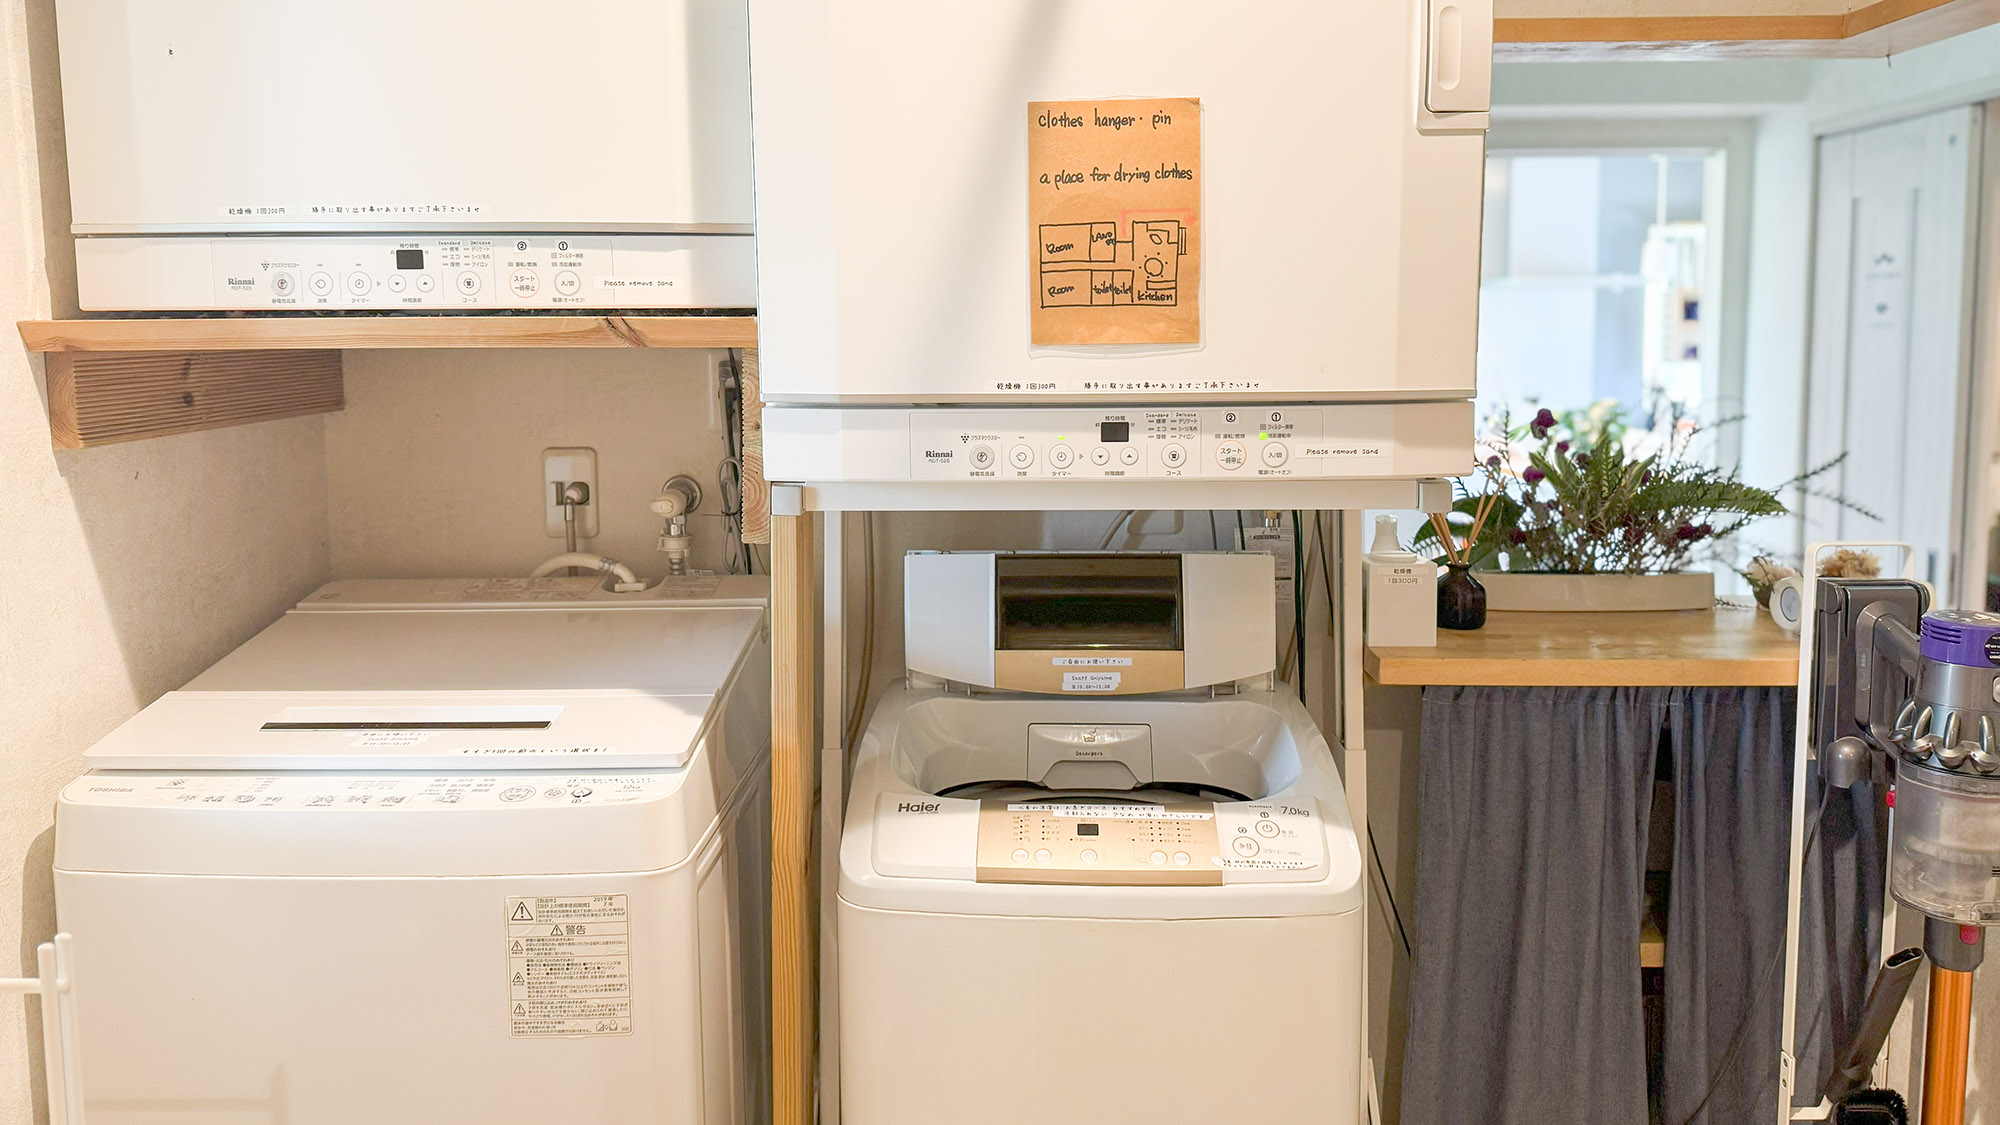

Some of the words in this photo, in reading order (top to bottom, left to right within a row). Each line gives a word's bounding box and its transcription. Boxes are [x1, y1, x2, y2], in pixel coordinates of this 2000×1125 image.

[1038, 109, 1084, 129] clothes
[1152, 109, 1172, 130] pin
[1039, 173, 1051, 185] a
[1054, 169, 1085, 190] place
[1089, 166, 1111, 182] for
[1113, 163, 1151, 183] drying
[1154, 162, 1193, 181] clothes
[1045, 242, 1074, 254] Room
[227, 277, 255, 286] Rinnai
[1047, 285, 1075, 297] Room
[996, 382, 1021, 391] 乾燥機
[925, 450, 953, 458] Rinnai
[1220, 447, 1243, 455] スタート
[897, 801, 941, 813] Haier
[1280, 805, 1310, 818] 7.0kg
[565, 925, 586, 935] 警告
